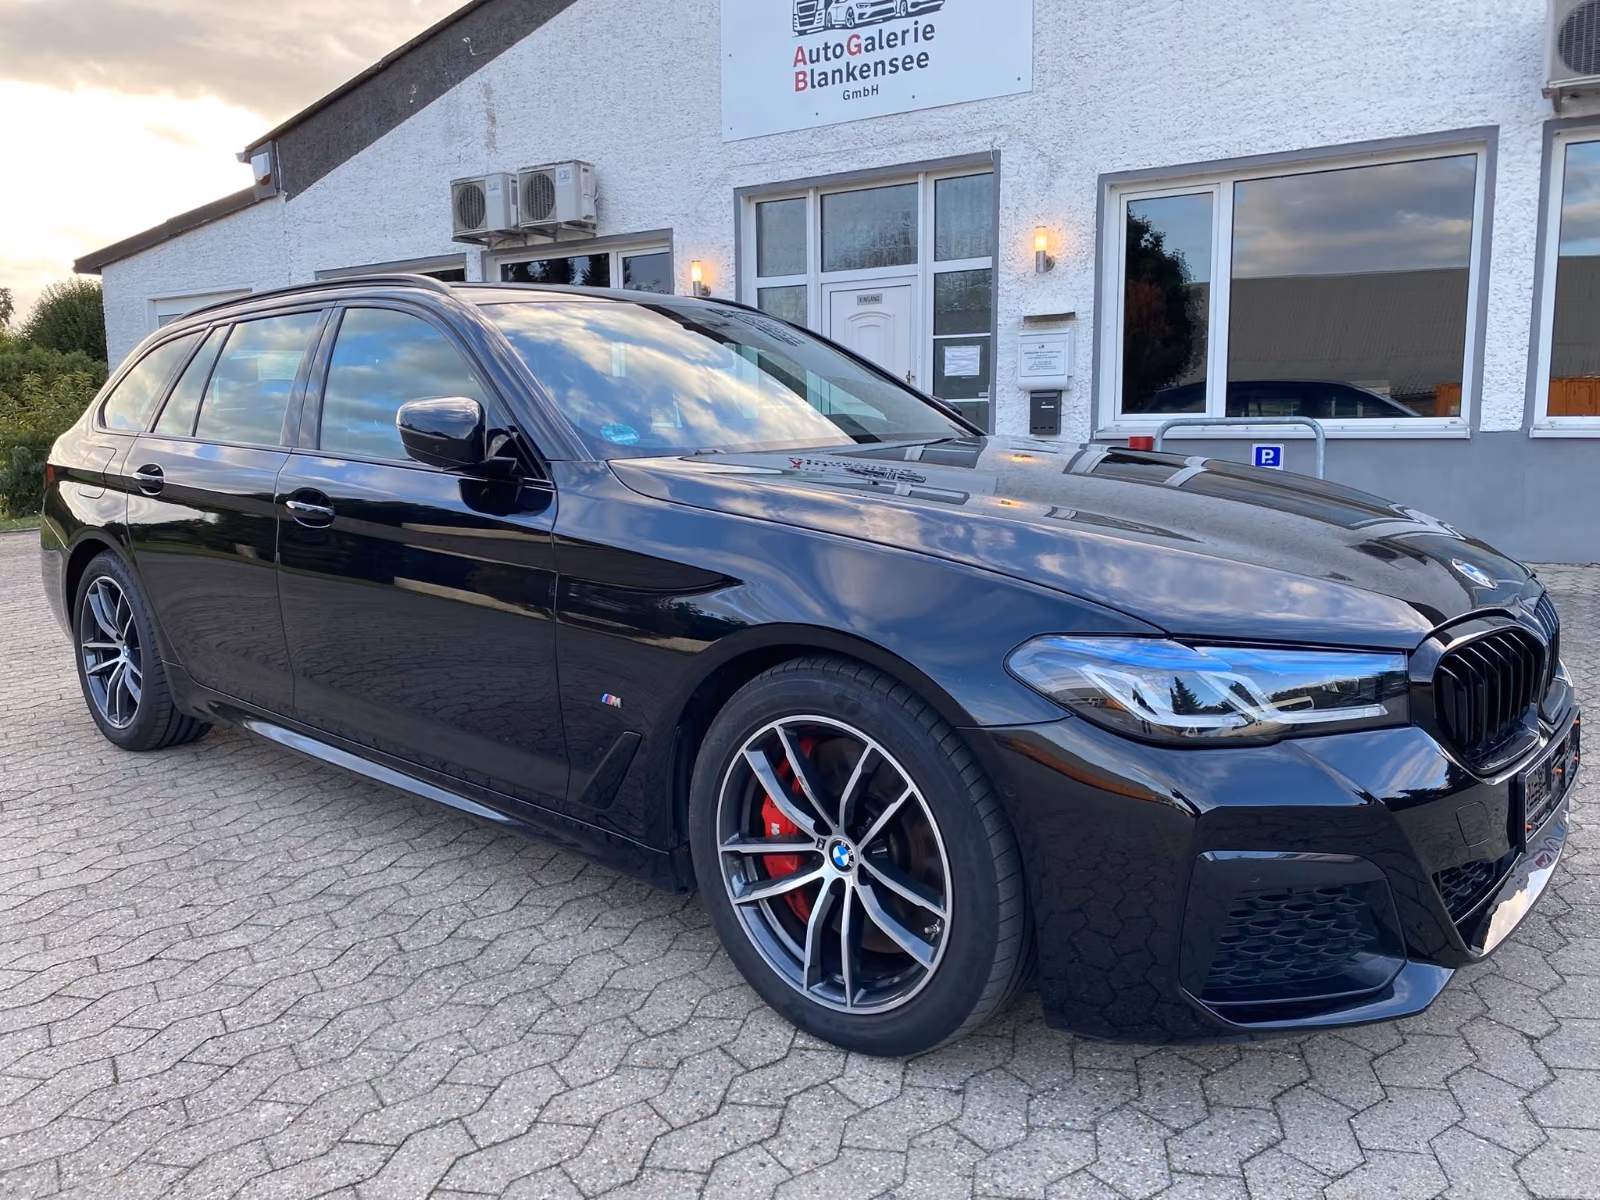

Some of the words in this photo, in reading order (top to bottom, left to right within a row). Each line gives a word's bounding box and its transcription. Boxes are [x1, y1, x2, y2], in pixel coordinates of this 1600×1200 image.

[793, 20, 935, 67] AutoGalerie
[795, 51, 930, 92] Blankensee
[842, 84, 879, 100] GmbH
[1261, 449, 1274, 464] P
